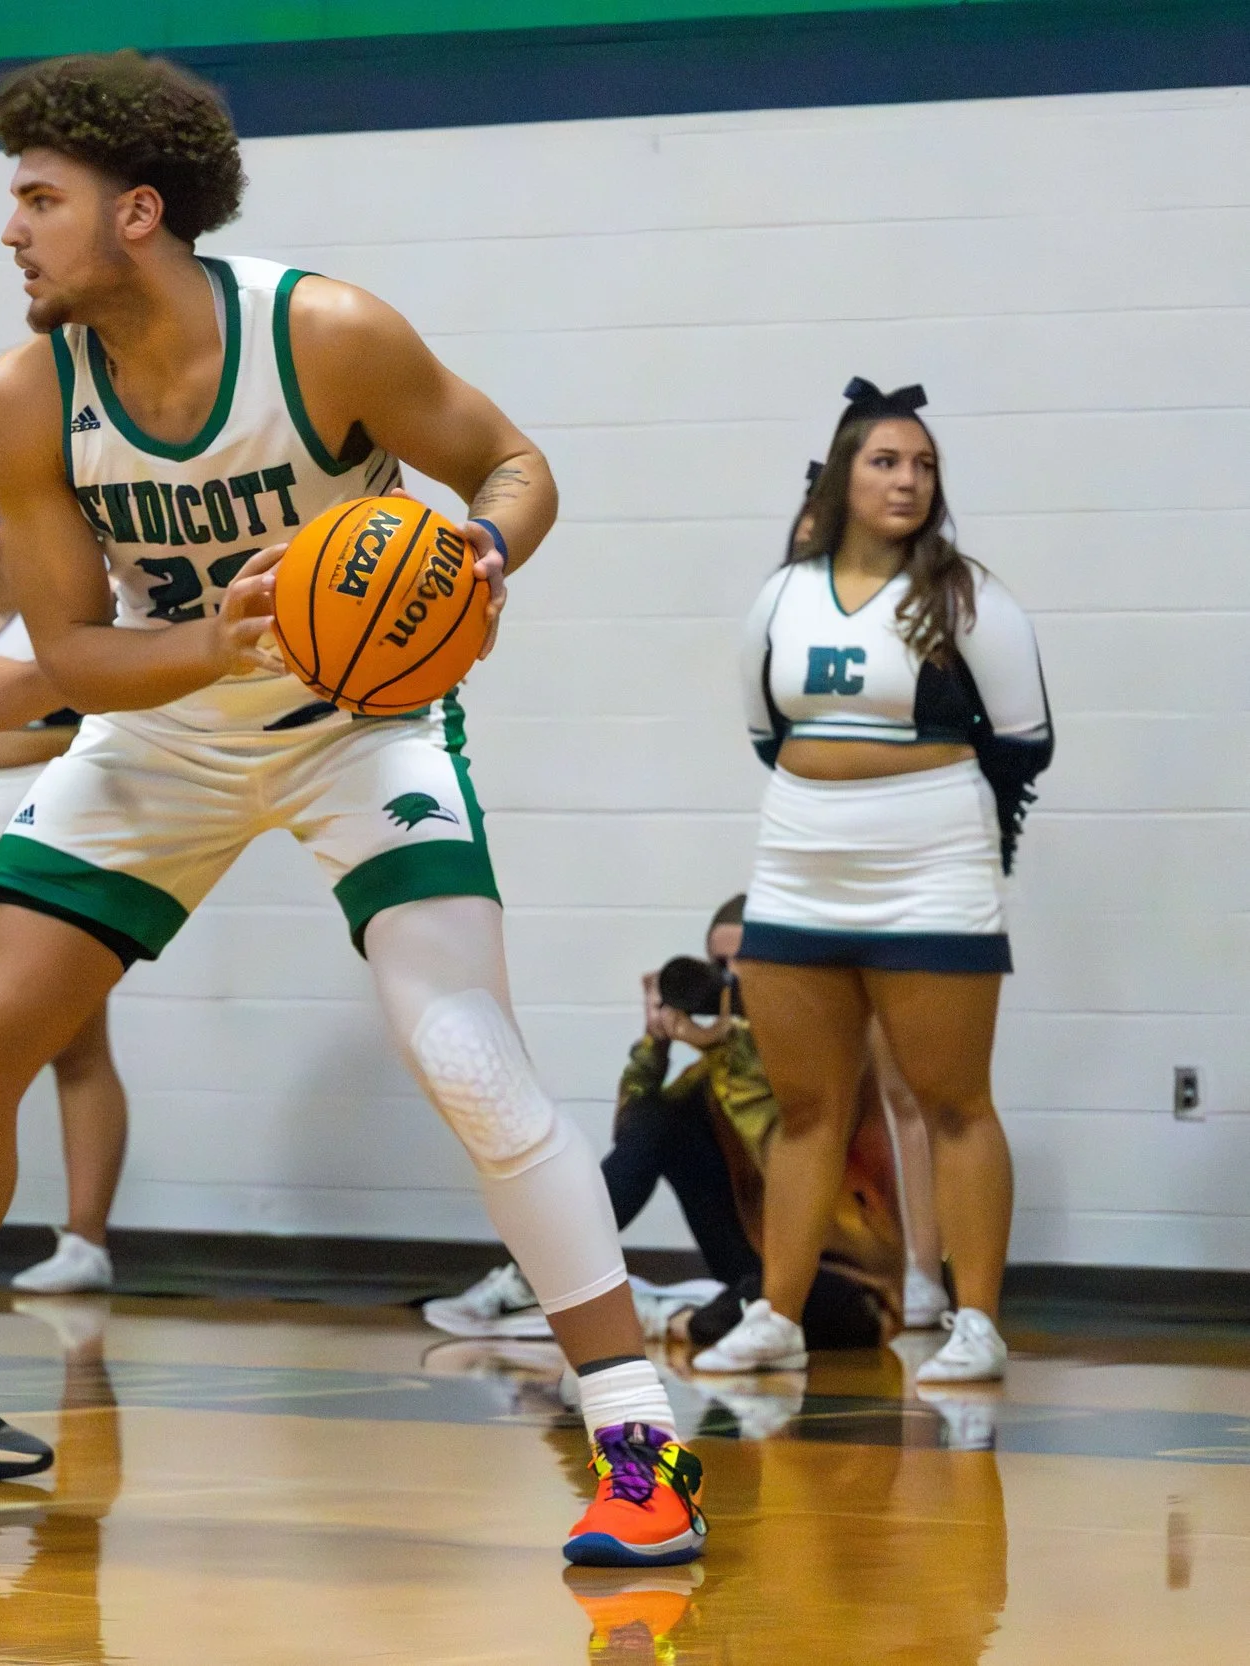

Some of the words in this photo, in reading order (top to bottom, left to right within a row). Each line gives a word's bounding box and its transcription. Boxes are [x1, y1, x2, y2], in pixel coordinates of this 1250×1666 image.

[76, 462, 300, 545] ENDICOTT
[335, 509, 403, 598] NCAA
[384, 526, 466, 648] Wilson
